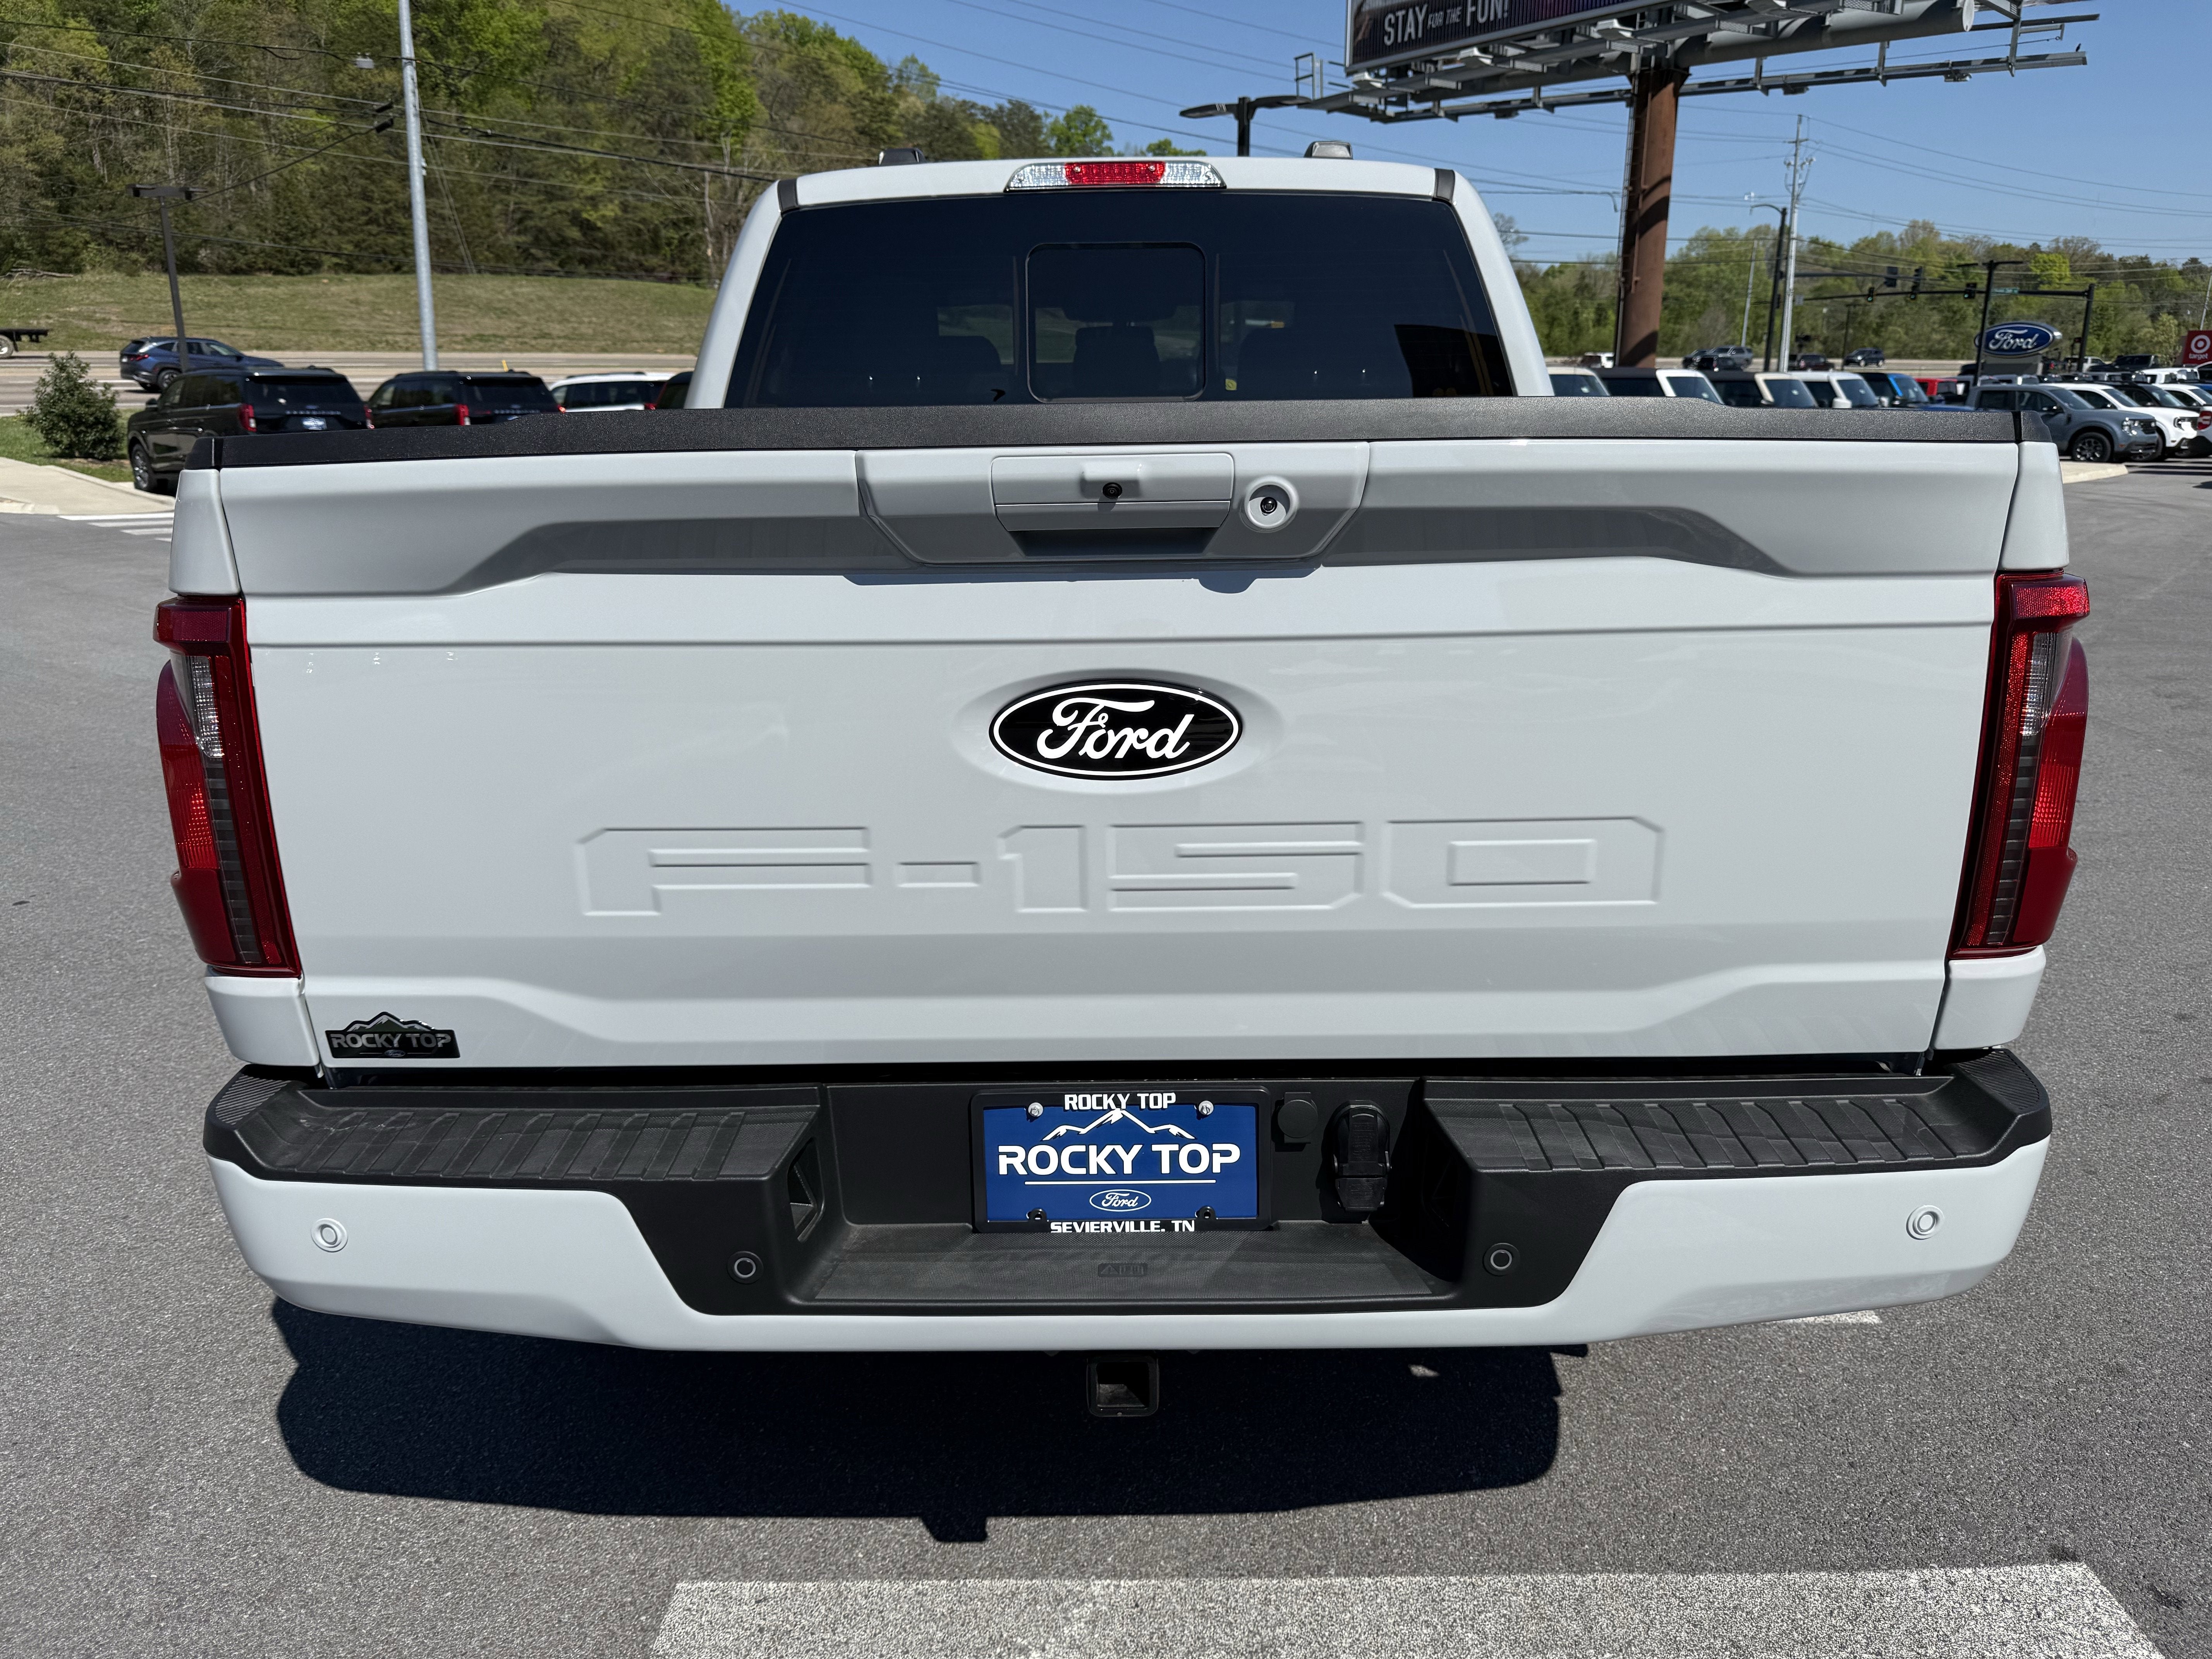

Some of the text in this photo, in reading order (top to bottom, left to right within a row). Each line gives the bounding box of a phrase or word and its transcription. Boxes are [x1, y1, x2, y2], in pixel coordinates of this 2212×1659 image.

[1384, 3, 1429, 46] STAY
[1427, 11, 1444, 30] FOR
[1445, 7, 1462, 25] THE
[1988, 329, 2040, 350] Ford
[1036, 697, 1195, 759] Ford
[575, 816, 1665, 916] F-150
[330, 1033, 452, 1048] ROCKY TOP
[1064, 1092, 1176, 1111] ROCKY TOP
[998, 1143, 1241, 1176] ROCKY TOP
[1101, 1192, 1139, 1207] Ford
[1171, 1219, 1195, 1232] TN
